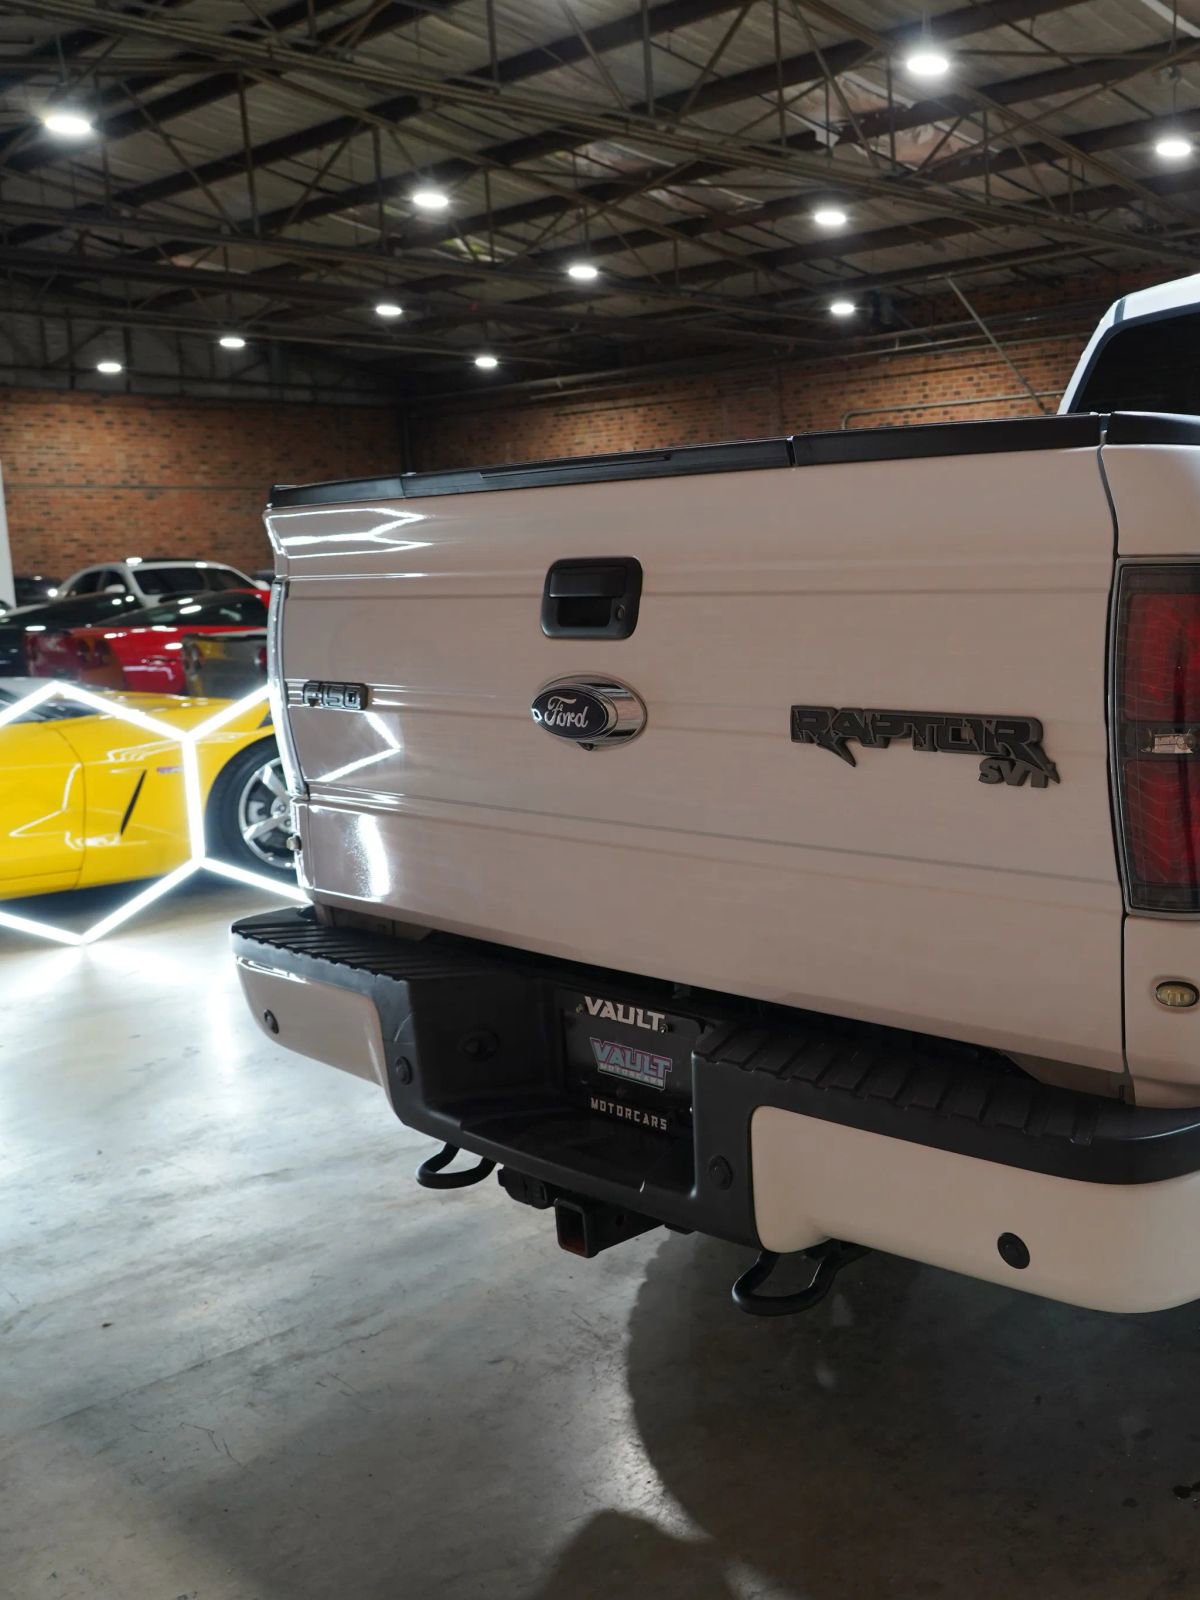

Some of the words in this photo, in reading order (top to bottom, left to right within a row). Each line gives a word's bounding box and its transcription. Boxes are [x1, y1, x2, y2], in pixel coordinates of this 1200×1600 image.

[544, 696, 588, 728] Ford
[790, 705, 1060, 785] RAPTOR
[978, 757, 1056, 788] SVT
[584, 996, 666, 1031] VAULT
[591, 1039, 672, 1079] VAULT
[590, 1097, 668, 1131] MOTORCARS
